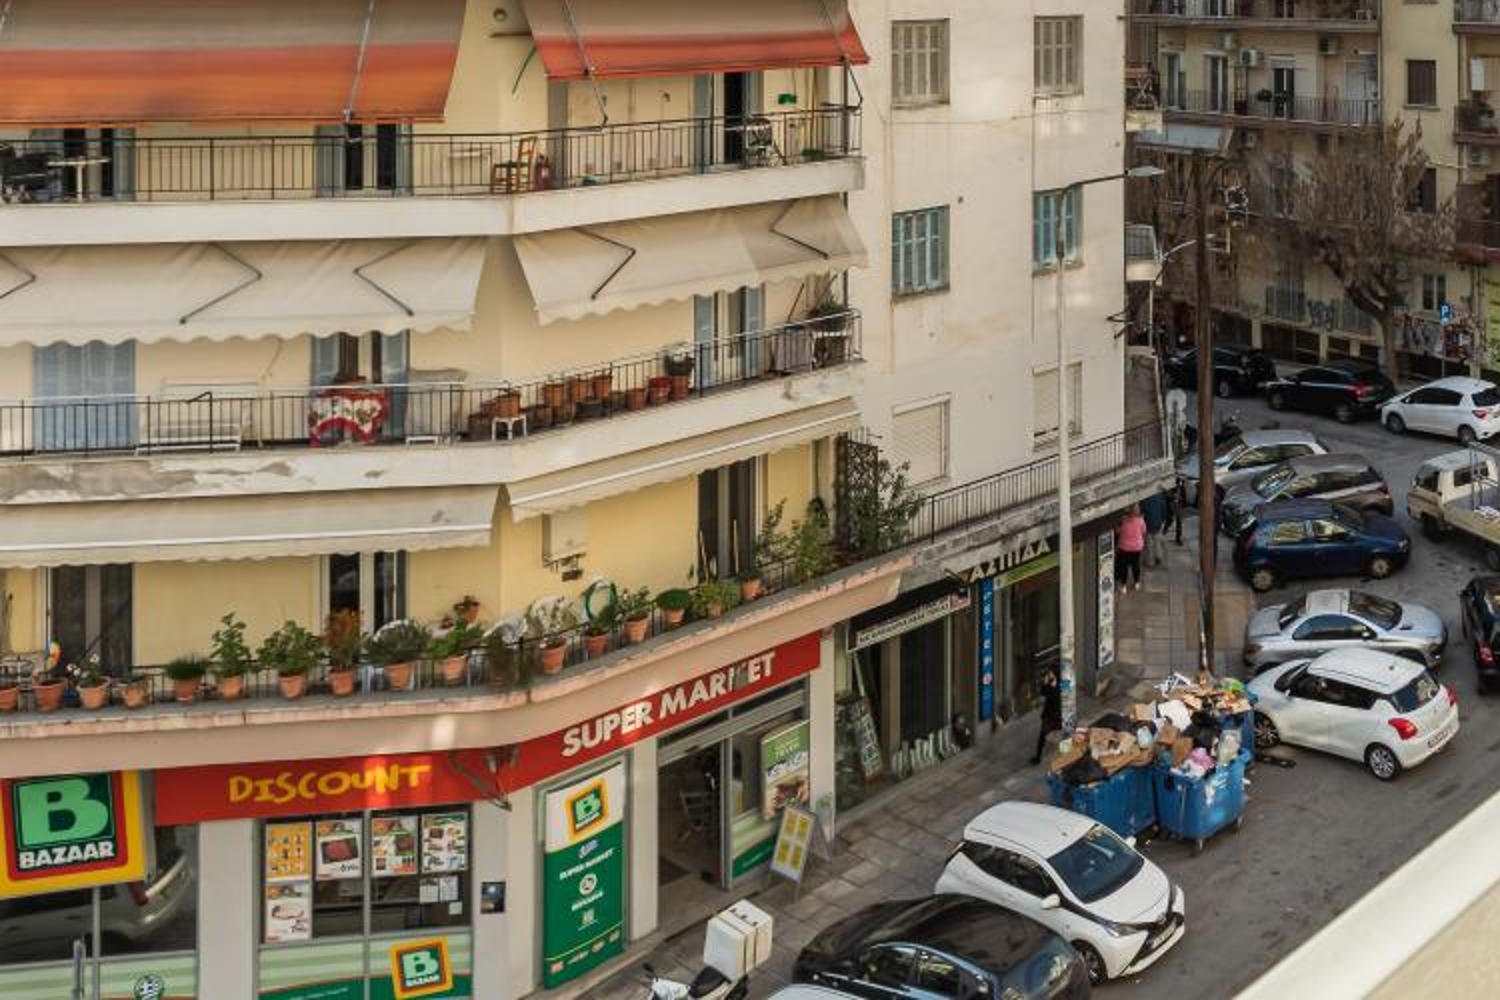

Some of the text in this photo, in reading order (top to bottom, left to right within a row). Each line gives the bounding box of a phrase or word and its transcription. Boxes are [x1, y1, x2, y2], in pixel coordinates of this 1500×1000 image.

[561, 700, 654, 757] SUPER
[229, 764, 432, 804] DISCOUNT
[19, 778, 109, 846] B
[19, 840, 115, 869] BAZAAR
[403, 951, 438, 978] B
